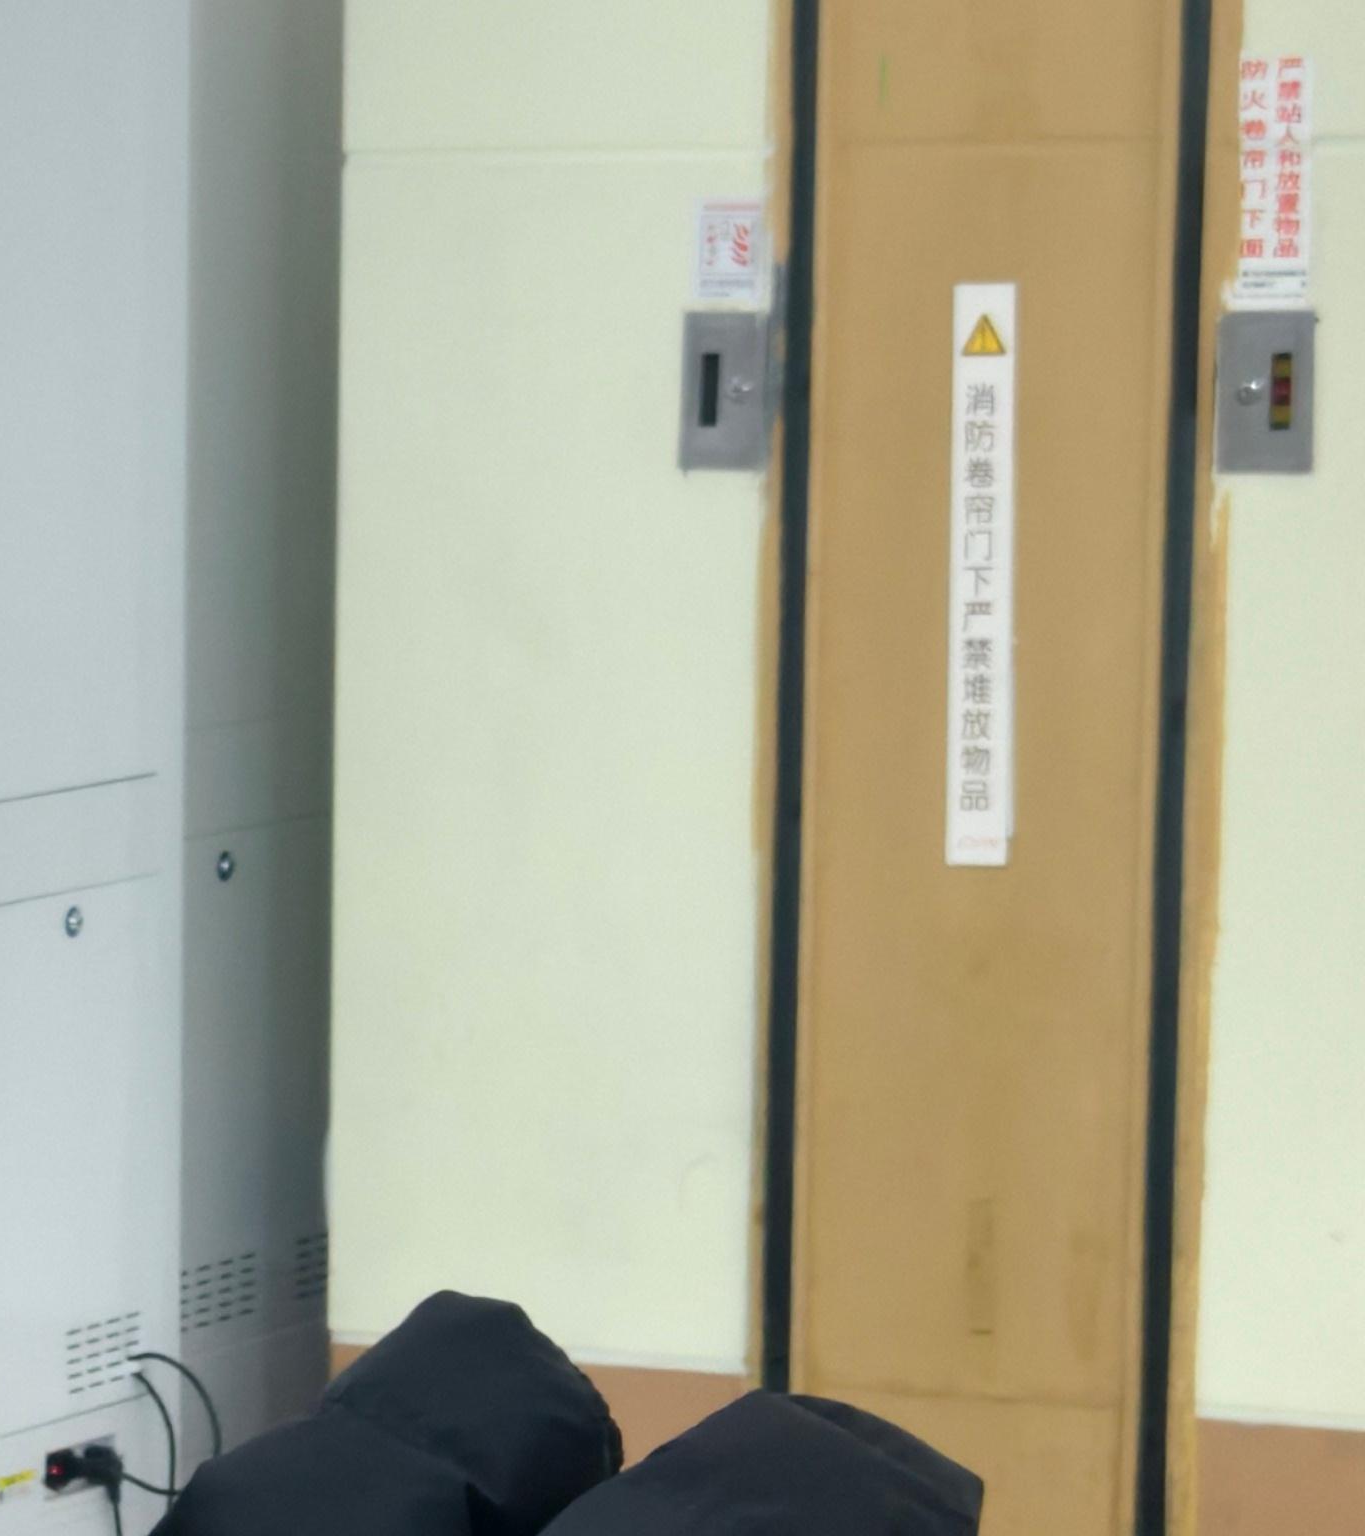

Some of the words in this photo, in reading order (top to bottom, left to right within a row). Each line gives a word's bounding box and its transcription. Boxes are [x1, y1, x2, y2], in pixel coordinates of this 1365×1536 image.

[1273, 57, 1303, 258] 严禁站人和放置物品
[959, 381, 998, 815] 消防卷帘门下严禁堆放物品
